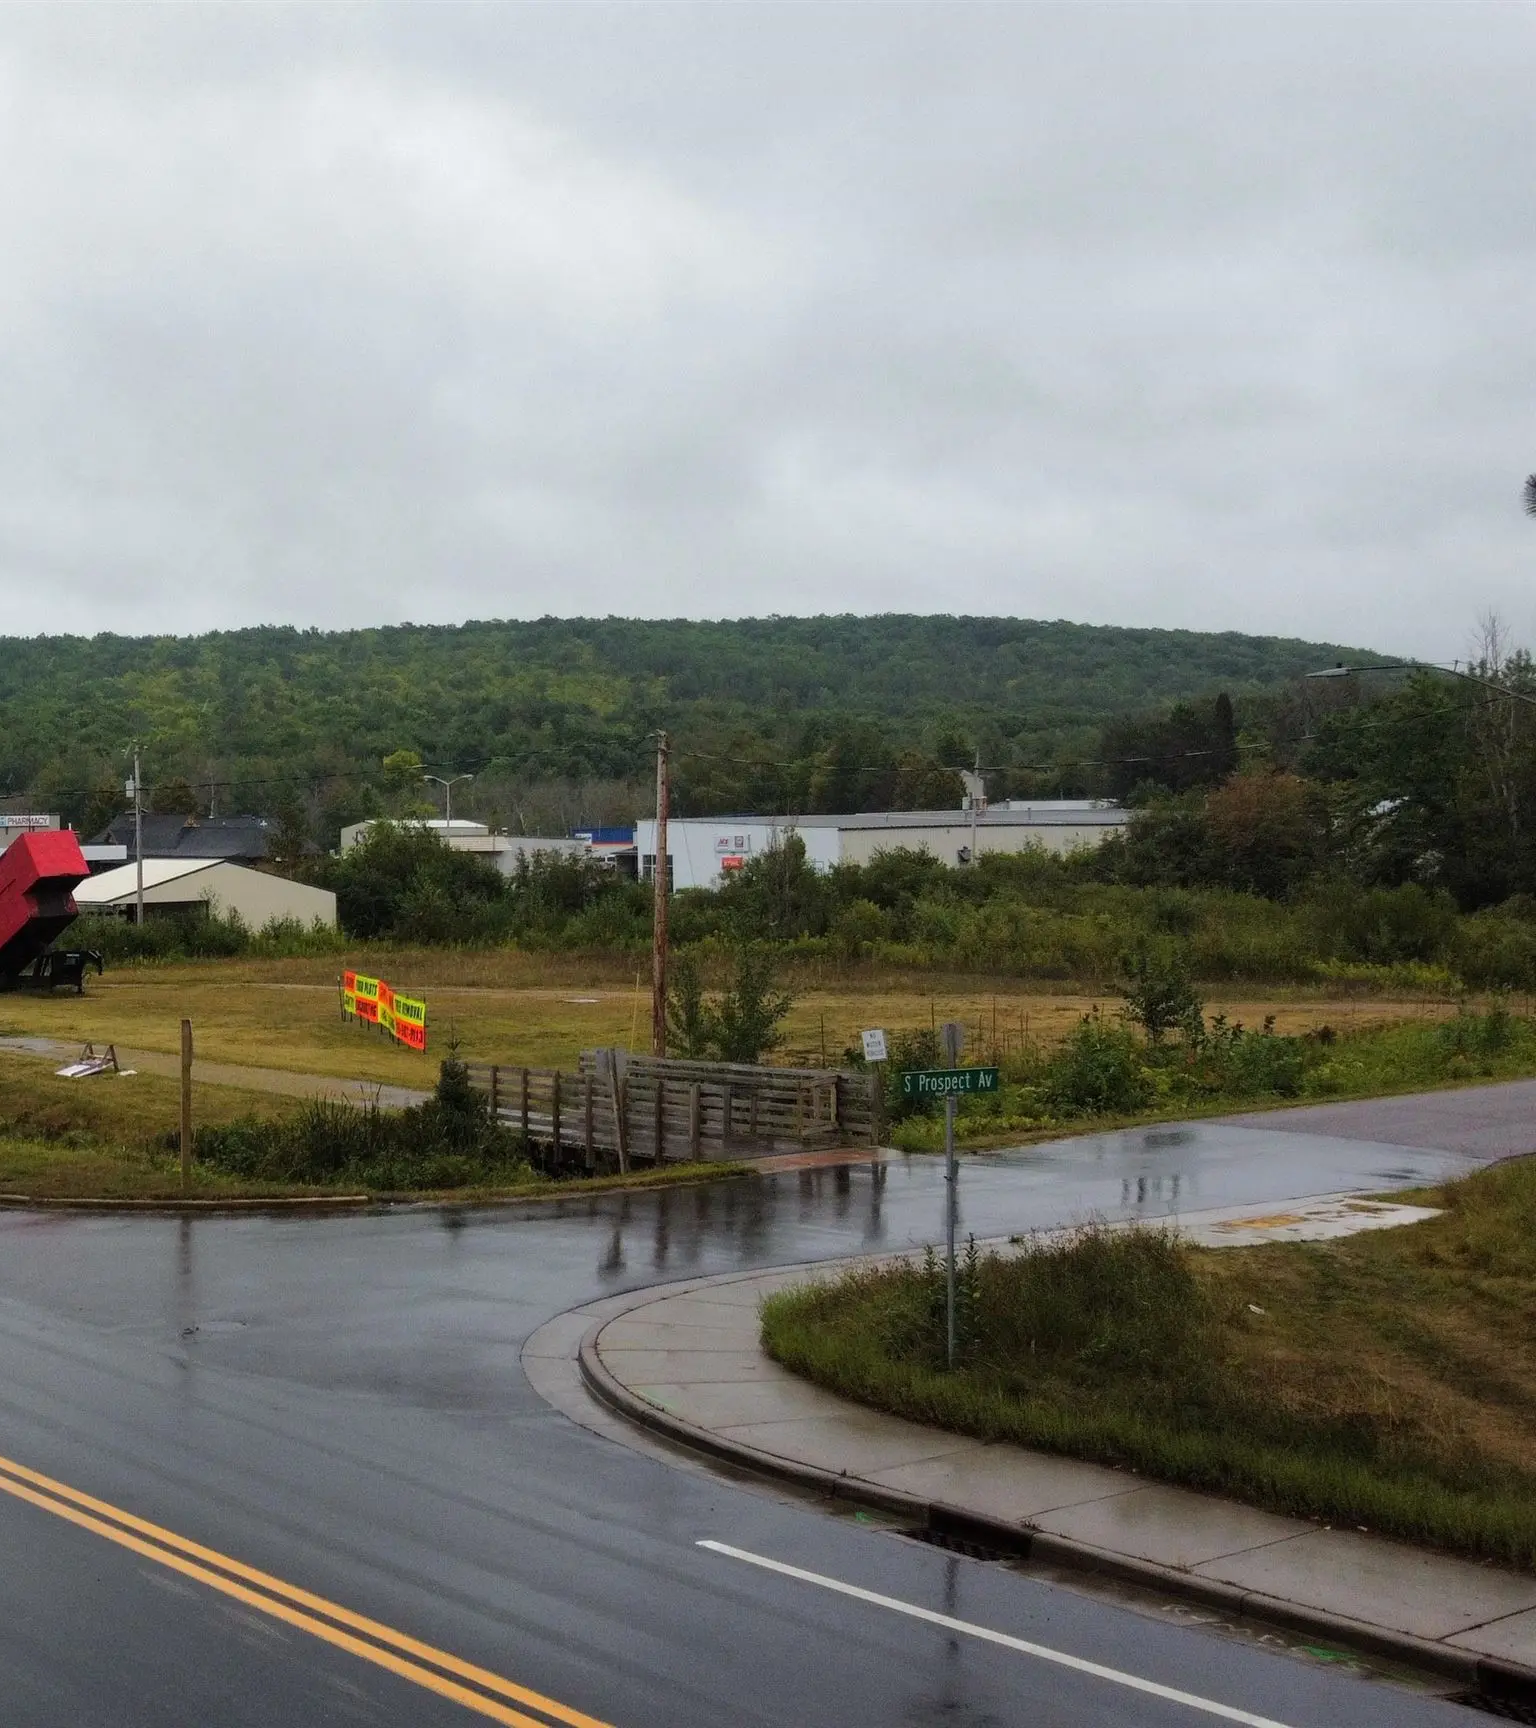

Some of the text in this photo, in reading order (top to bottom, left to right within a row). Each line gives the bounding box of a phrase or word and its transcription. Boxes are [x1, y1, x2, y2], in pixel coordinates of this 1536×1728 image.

[7, 817, 49, 826] PHARMACY
[904, 1071, 993, 1093] S Prospect Av
